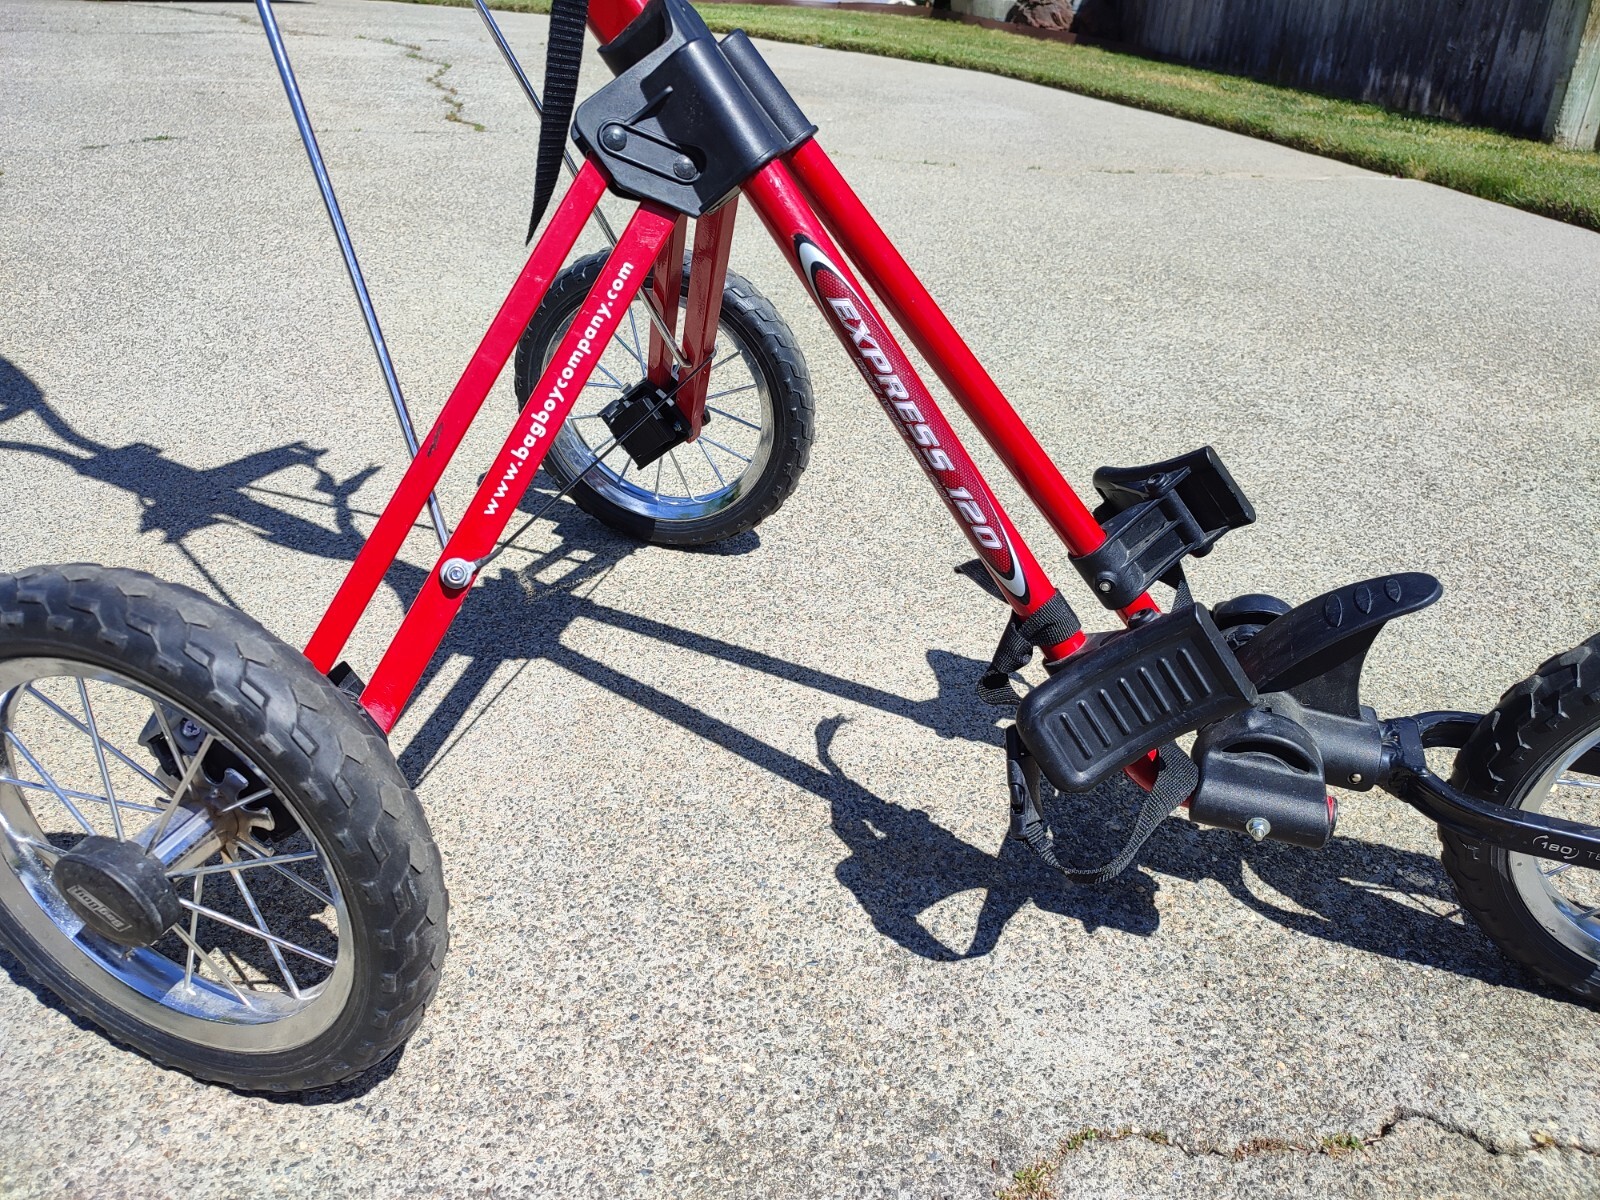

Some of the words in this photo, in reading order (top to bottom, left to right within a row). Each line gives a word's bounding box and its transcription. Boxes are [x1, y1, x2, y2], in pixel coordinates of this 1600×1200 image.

[484, 261, 634, 515] www.bagboycompany.com
[826, 297, 955, 472] EXPRESS
[949, 486, 1003, 550] 120
